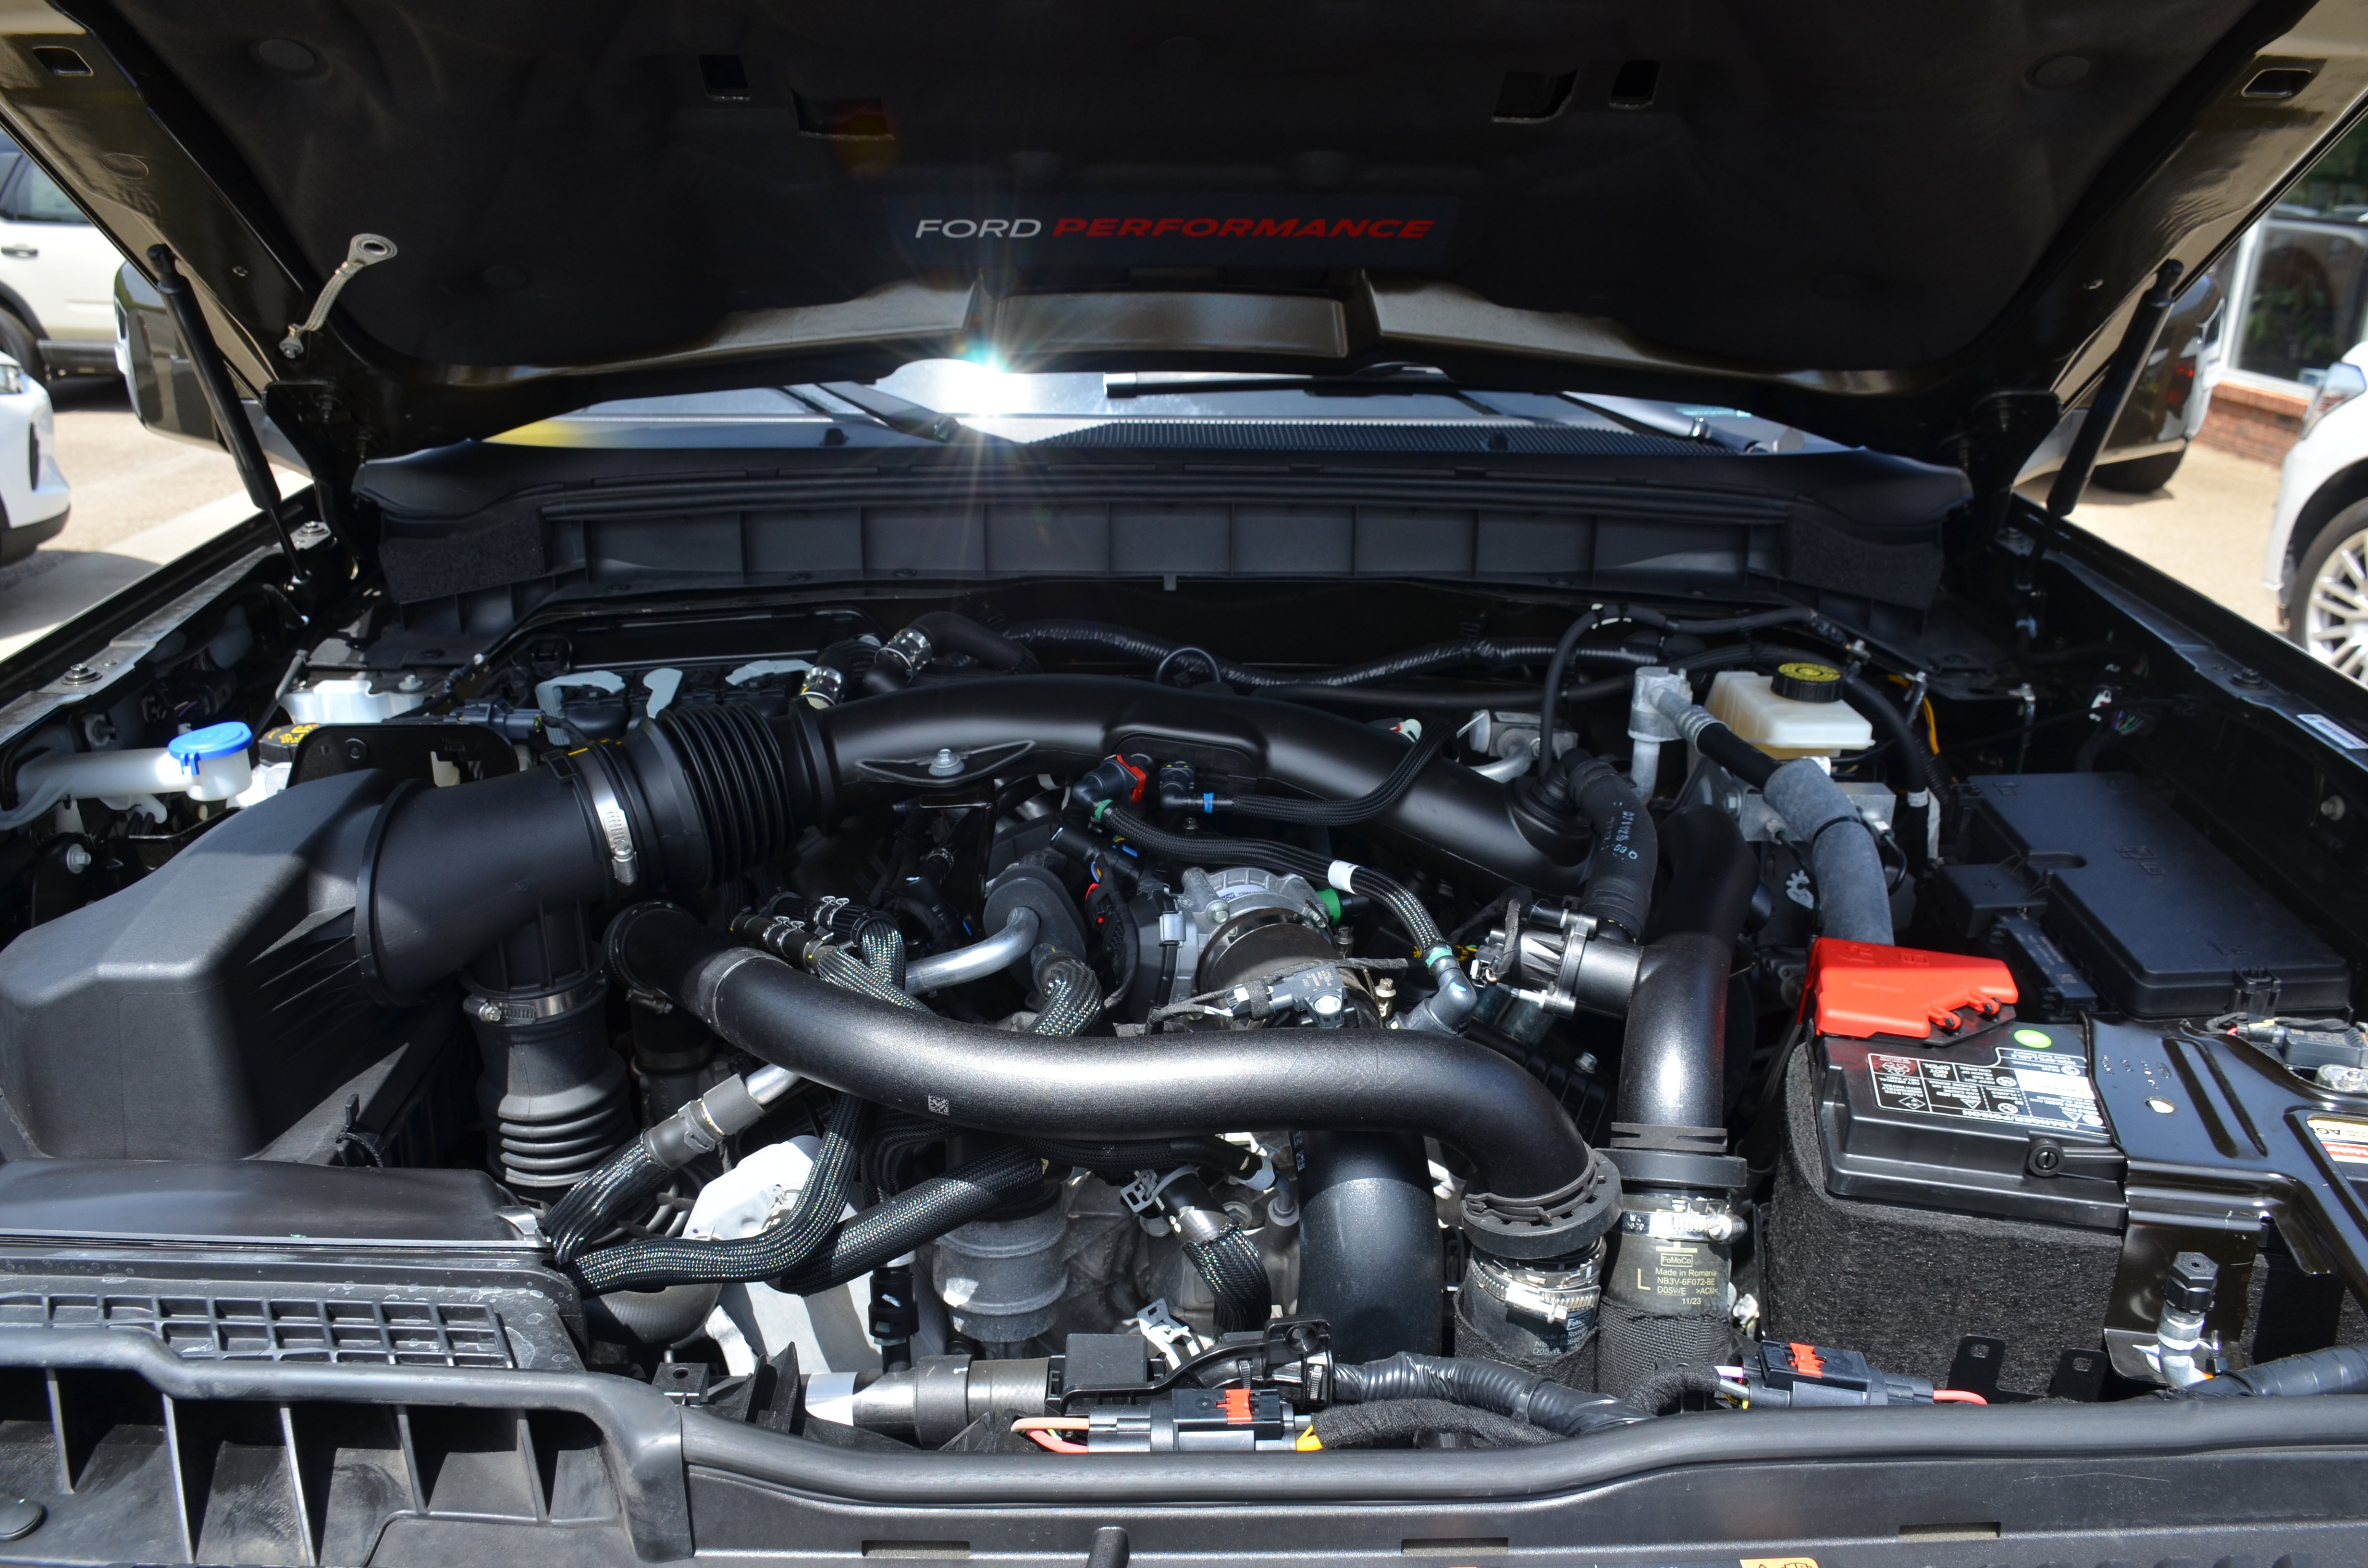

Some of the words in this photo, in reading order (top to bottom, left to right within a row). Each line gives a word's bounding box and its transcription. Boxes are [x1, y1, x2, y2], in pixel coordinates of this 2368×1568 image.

[914, 219, 1042, 238] FORD
[1052, 218, 1434, 239] PERFORMANCE
[2010, 1054, 2076, 1065] NON-SPILLABLE
[1962, 1110, 2068, 1128] DANGER/POISON
[1662, 1256, 1691, 1264] FoMoCo
[1655, 1268, 1677, 1276] Made
[1638, 1268, 1651, 1291] L
[1657, 1277, 1715, 1286] NB3V-6F072-BE
[1657, 1286, 1687, 1295] D05WE
